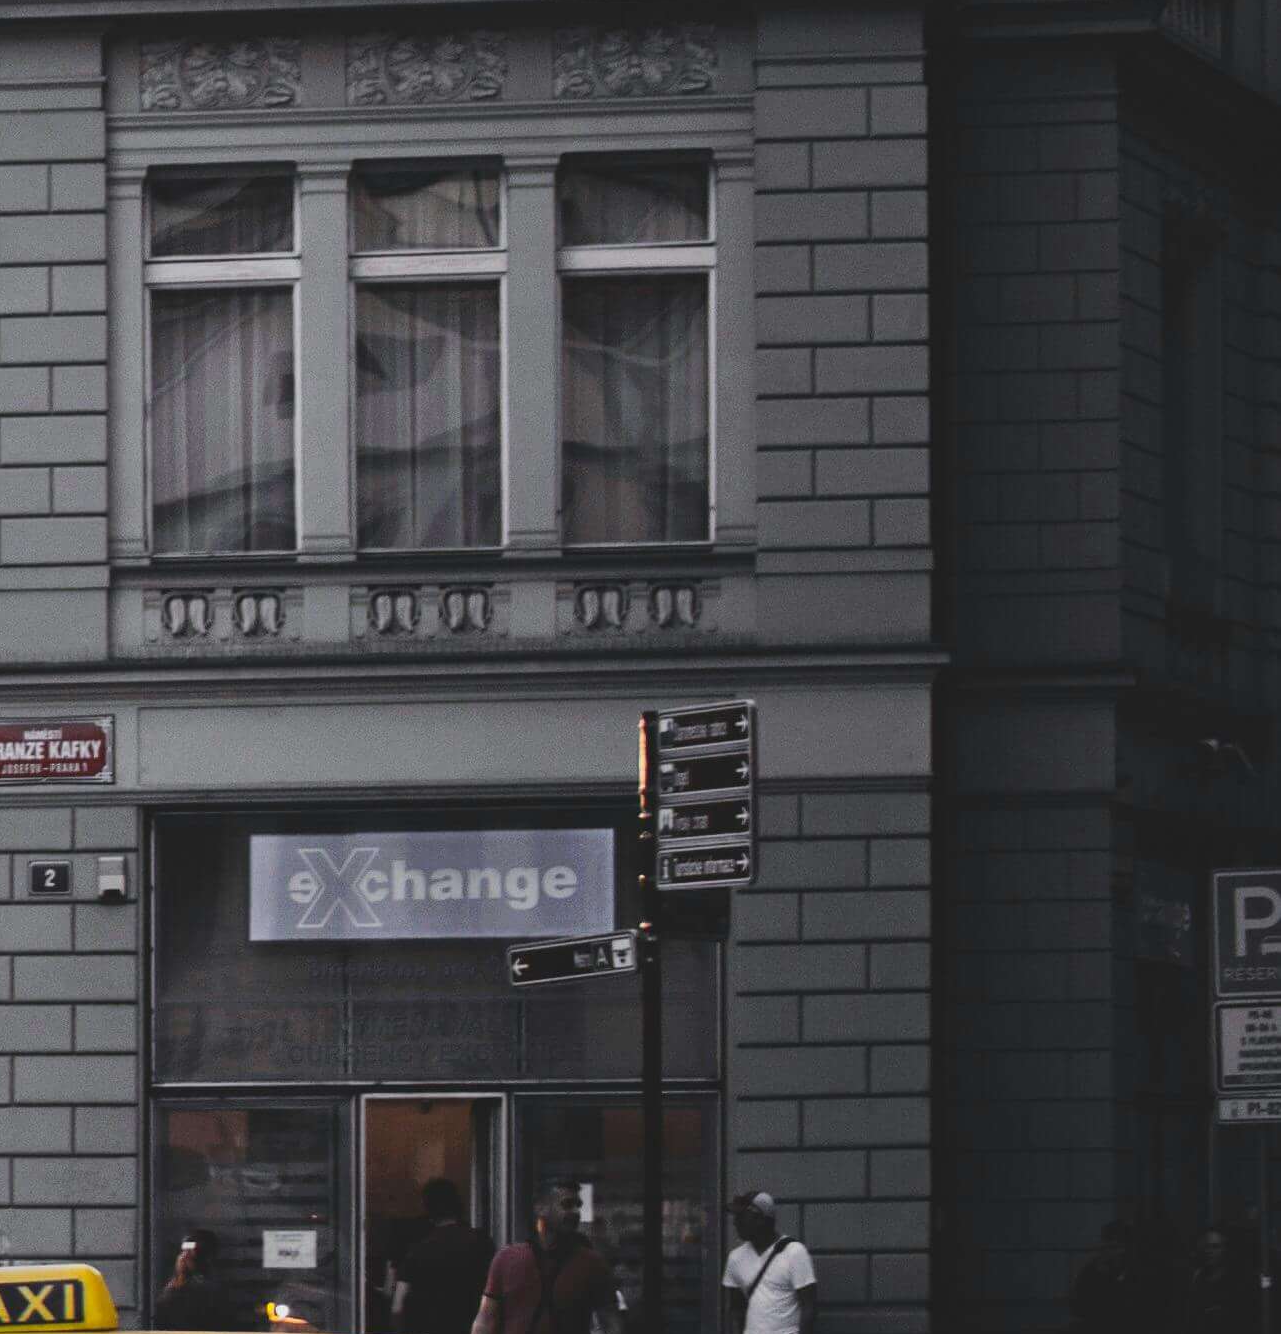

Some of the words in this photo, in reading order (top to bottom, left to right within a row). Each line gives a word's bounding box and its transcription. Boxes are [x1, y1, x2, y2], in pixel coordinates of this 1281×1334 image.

[49, 740, 102, 759] KAFKY
[44, 869, 56, 887] 2
[288, 847, 578, 929] eXchange
[1235, 886, 1281, 956] P
